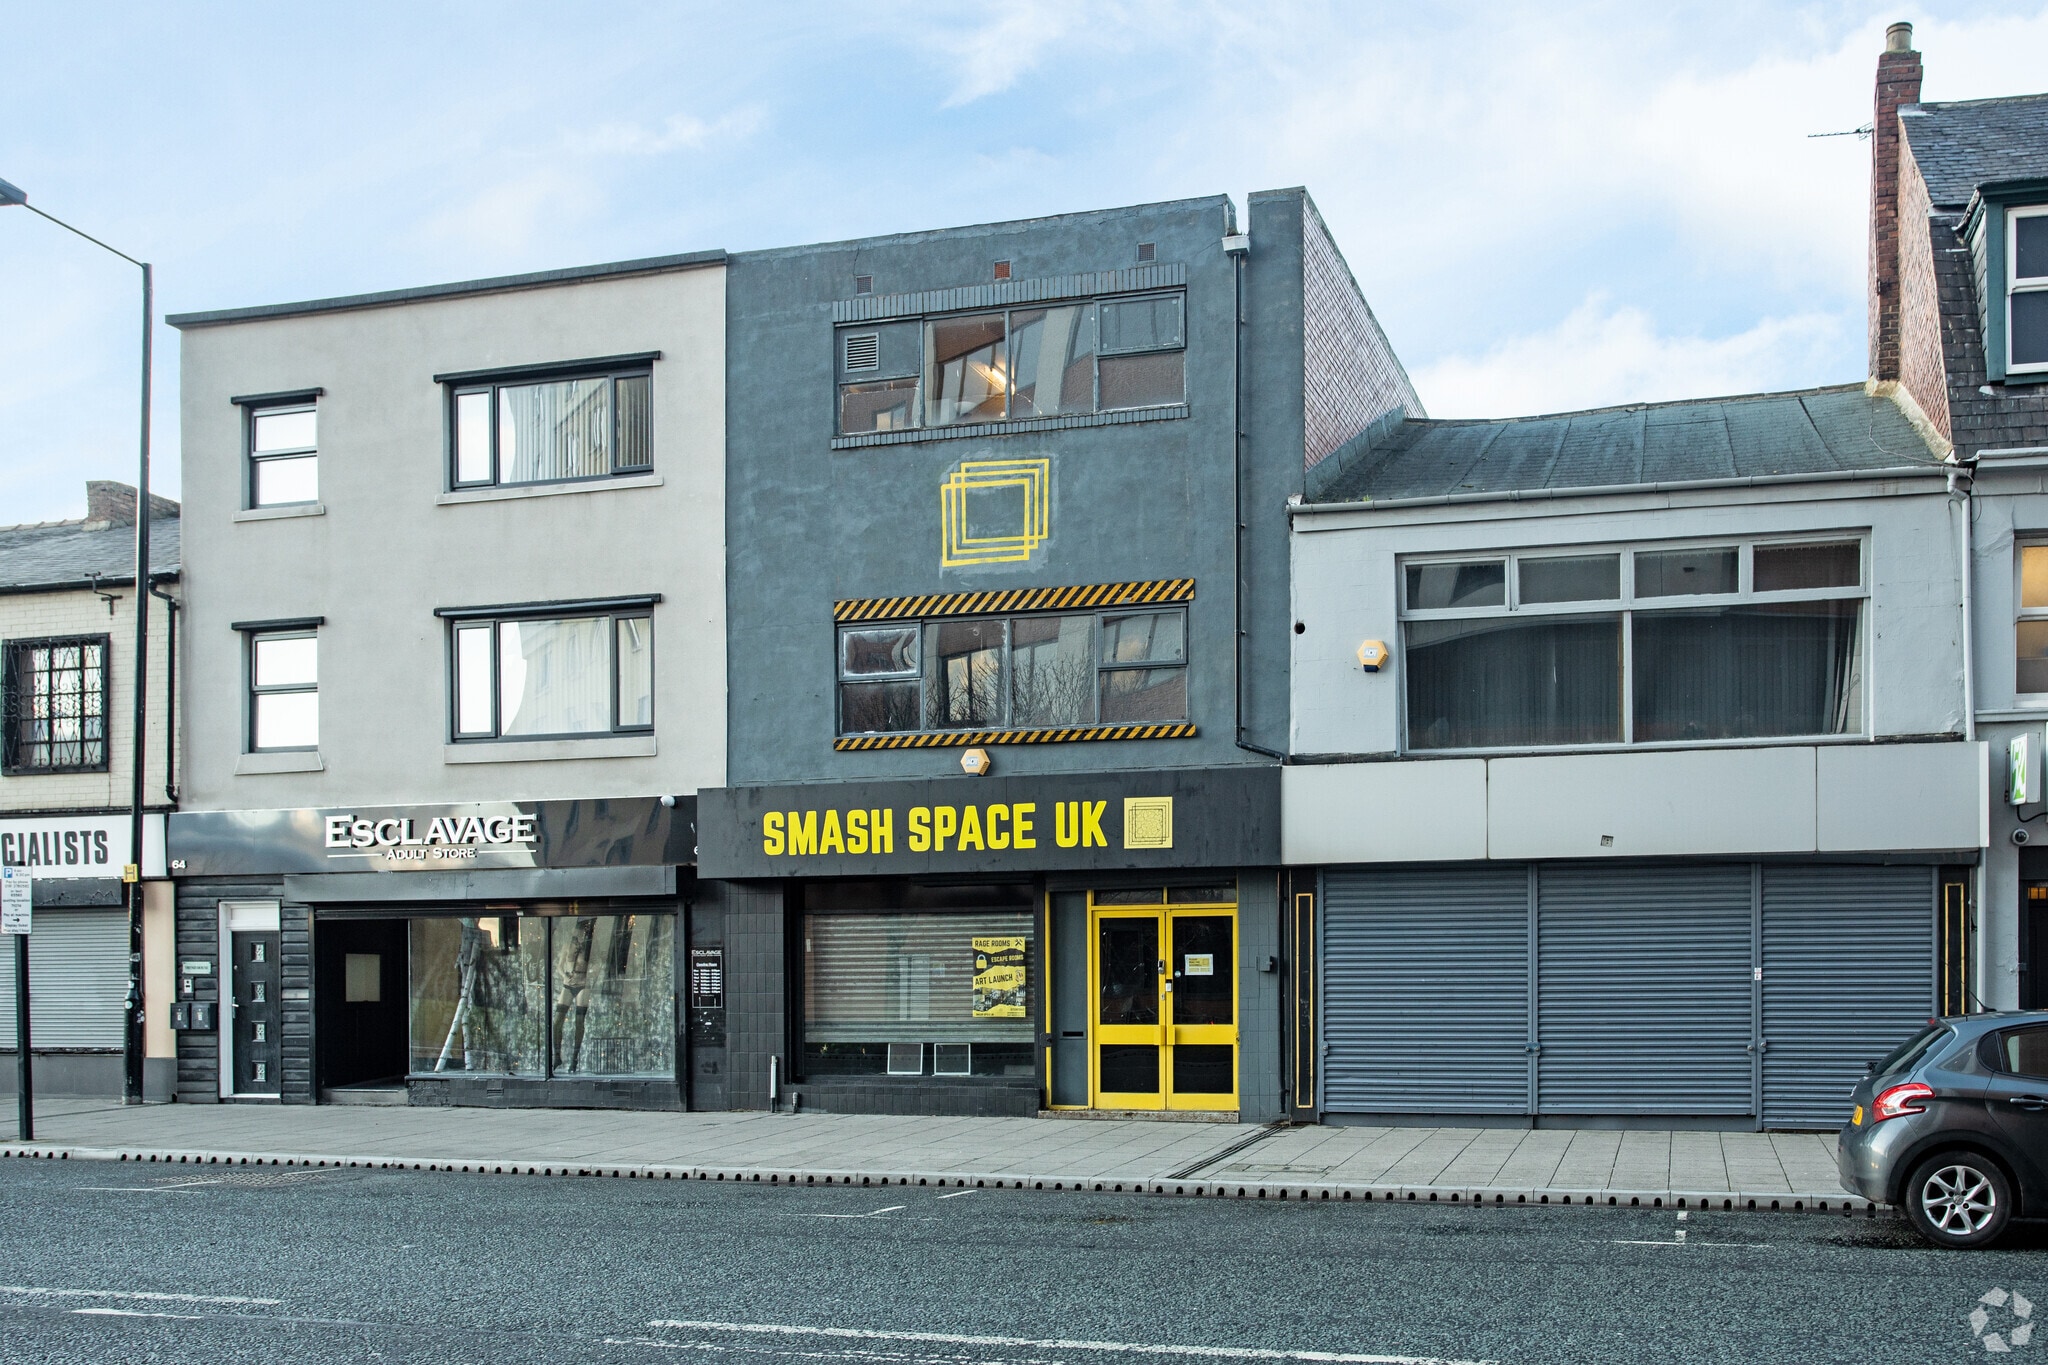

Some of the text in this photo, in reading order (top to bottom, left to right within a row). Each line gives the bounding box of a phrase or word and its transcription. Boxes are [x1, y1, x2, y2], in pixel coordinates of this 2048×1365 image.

[325, 813, 539, 849] ESCLAVAGE
[762, 800, 1108, 856] SMASH SPACE UK
[1, 830, 108, 867] CIALISTS
[386, 846, 477, 861] ADULT STORE
[172, 860, 187, 869] 64
[126, 865, 136, 880] H
[975, 939, 1010, 947] RAGE ROOMS
[991, 955, 1008, 963] ESCAPE
[975, 974, 1013, 986] ART LAUNCH
